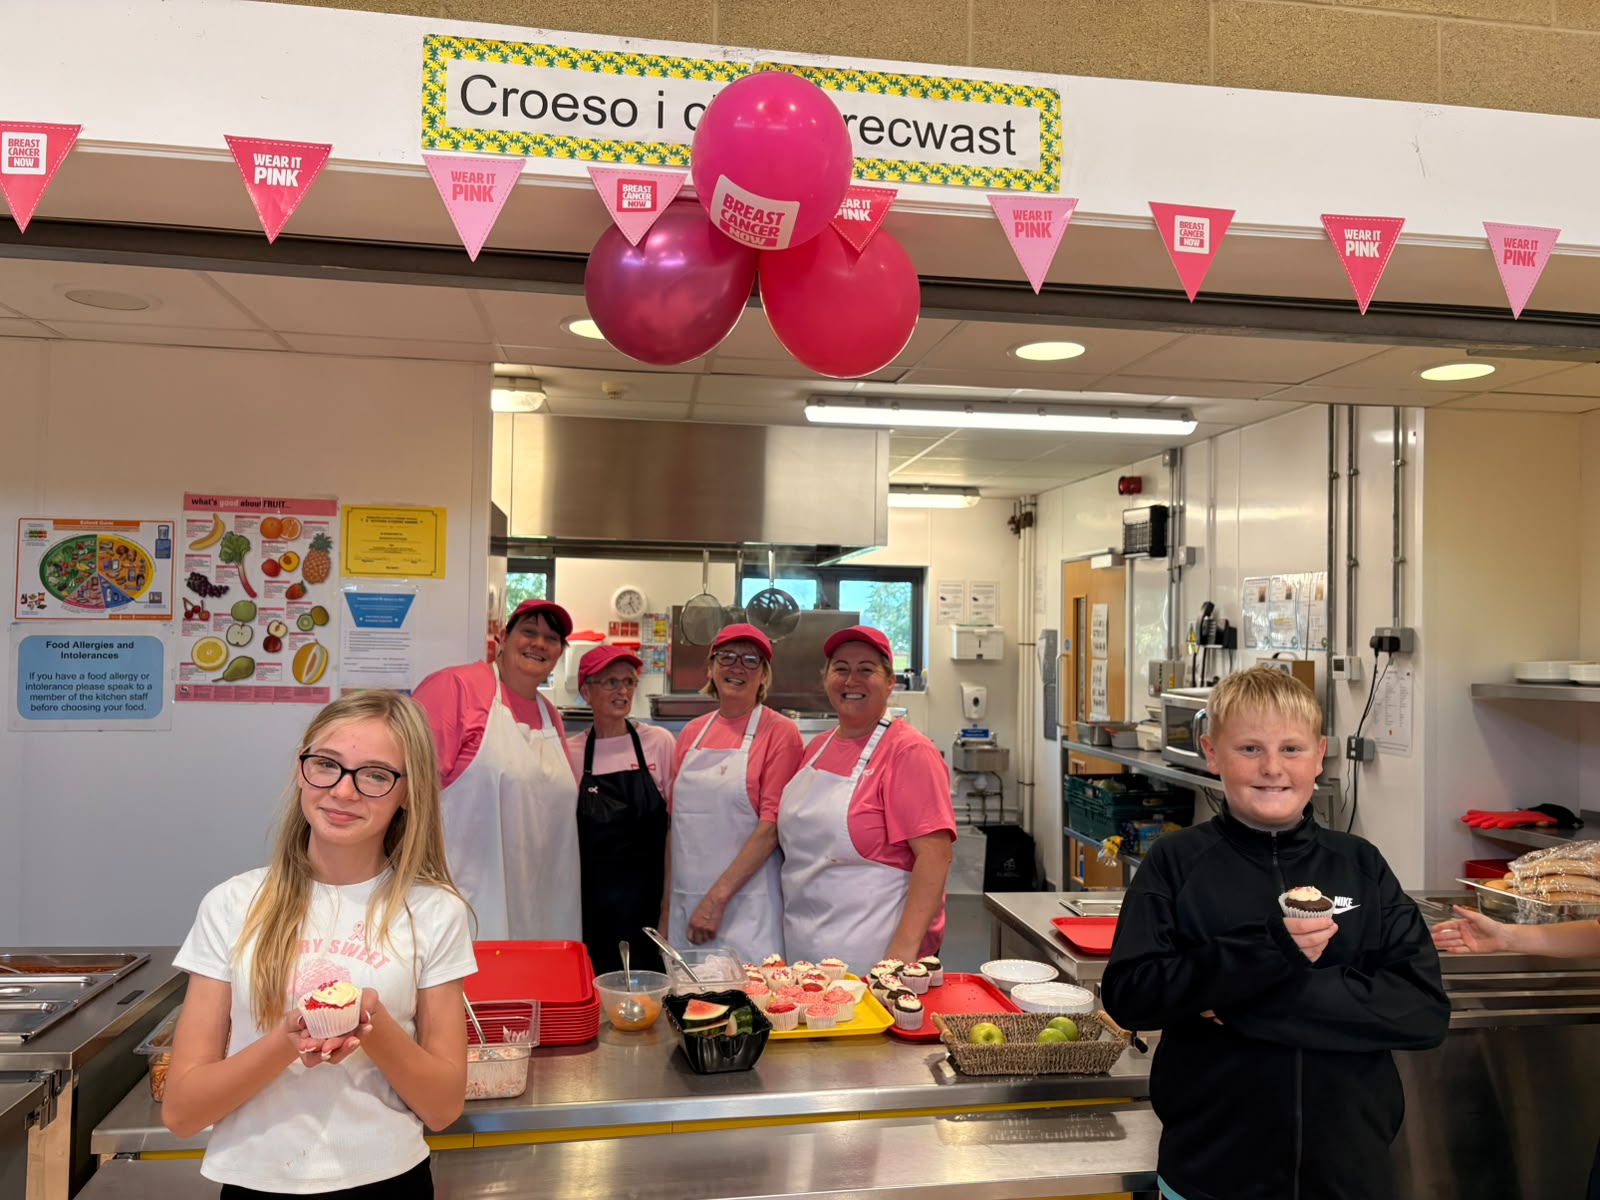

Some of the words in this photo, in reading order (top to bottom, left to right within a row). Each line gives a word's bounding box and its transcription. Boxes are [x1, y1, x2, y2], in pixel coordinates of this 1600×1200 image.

[460, 74, 638, 128] Croeso
[657, 90, 664, 129] i
[8, 138, 40, 148] BREAST
[8, 147, 40, 157] CANCER
[13, 157, 35, 167] NOW
[253, 153, 290, 168] WEAR
[291, 156, 302, 169] IT
[253, 166, 300, 187] PINK
[451, 170, 485, 184] WEAR
[486, 173, 496, 185] IT
[452, 184, 495, 203] PINK
[622, 184, 652, 193] BREAST
[622, 192, 652, 201] CANCER
[627, 200, 647, 208] NOW
[722, 192, 786, 226] BREAST
[862, 199, 872, 209] IT
[1012, 209, 1042, 221] WEAR
[1044, 210, 1053, 221] IT
[721, 208, 780, 237] CANCER
[1179, 221, 1205, 231] BREAST
[1015, 221, 1052, 239] PINK
[1179, 229, 1205, 239] CANCER
[1344, 228, 1372, 241] WEAR
[1373, 230, 1381, 241] IT
[729, 226, 767, 246] NOW
[1183, 237, 1201, 247] NOW
[1503, 237, 1530, 250] WEAR
[1531, 239, 1539, 251] IT
[1345, 240, 1381, 258] PINK
[1503, 249, 1537, 267] PINK
[220, 499, 239, 508] good
[46, 640, 70, 649] Food
[72, 640, 114, 651] Allergies
[117, 641, 134, 649] and
[60, 651, 119, 660] Intolerances
[30, 672, 35, 680] If
[37, 674, 53, 682] you
[55, 672, 77, 680] have
[87, 672, 107, 680] food
[109, 672, 138, 682] allergy
[25, 682, 74, 690] intolerance
[76, 682, 105, 691] please
[107, 682, 134, 691] speak
[30, 693, 66, 701] member
[68, 693, 77, 701] of
[79, 693, 94, 701] the
[95, 692, 127, 701] kitchen
[129, 692, 149, 701] staff
[30, 703, 59, 711] before
[61, 703, 101, 712] choosing
[103, 704, 123, 712] your
[125, 703, 147, 711] food.
[1334, 895, 1353, 907] NIKE
[328, 940, 391, 971] SWEET
